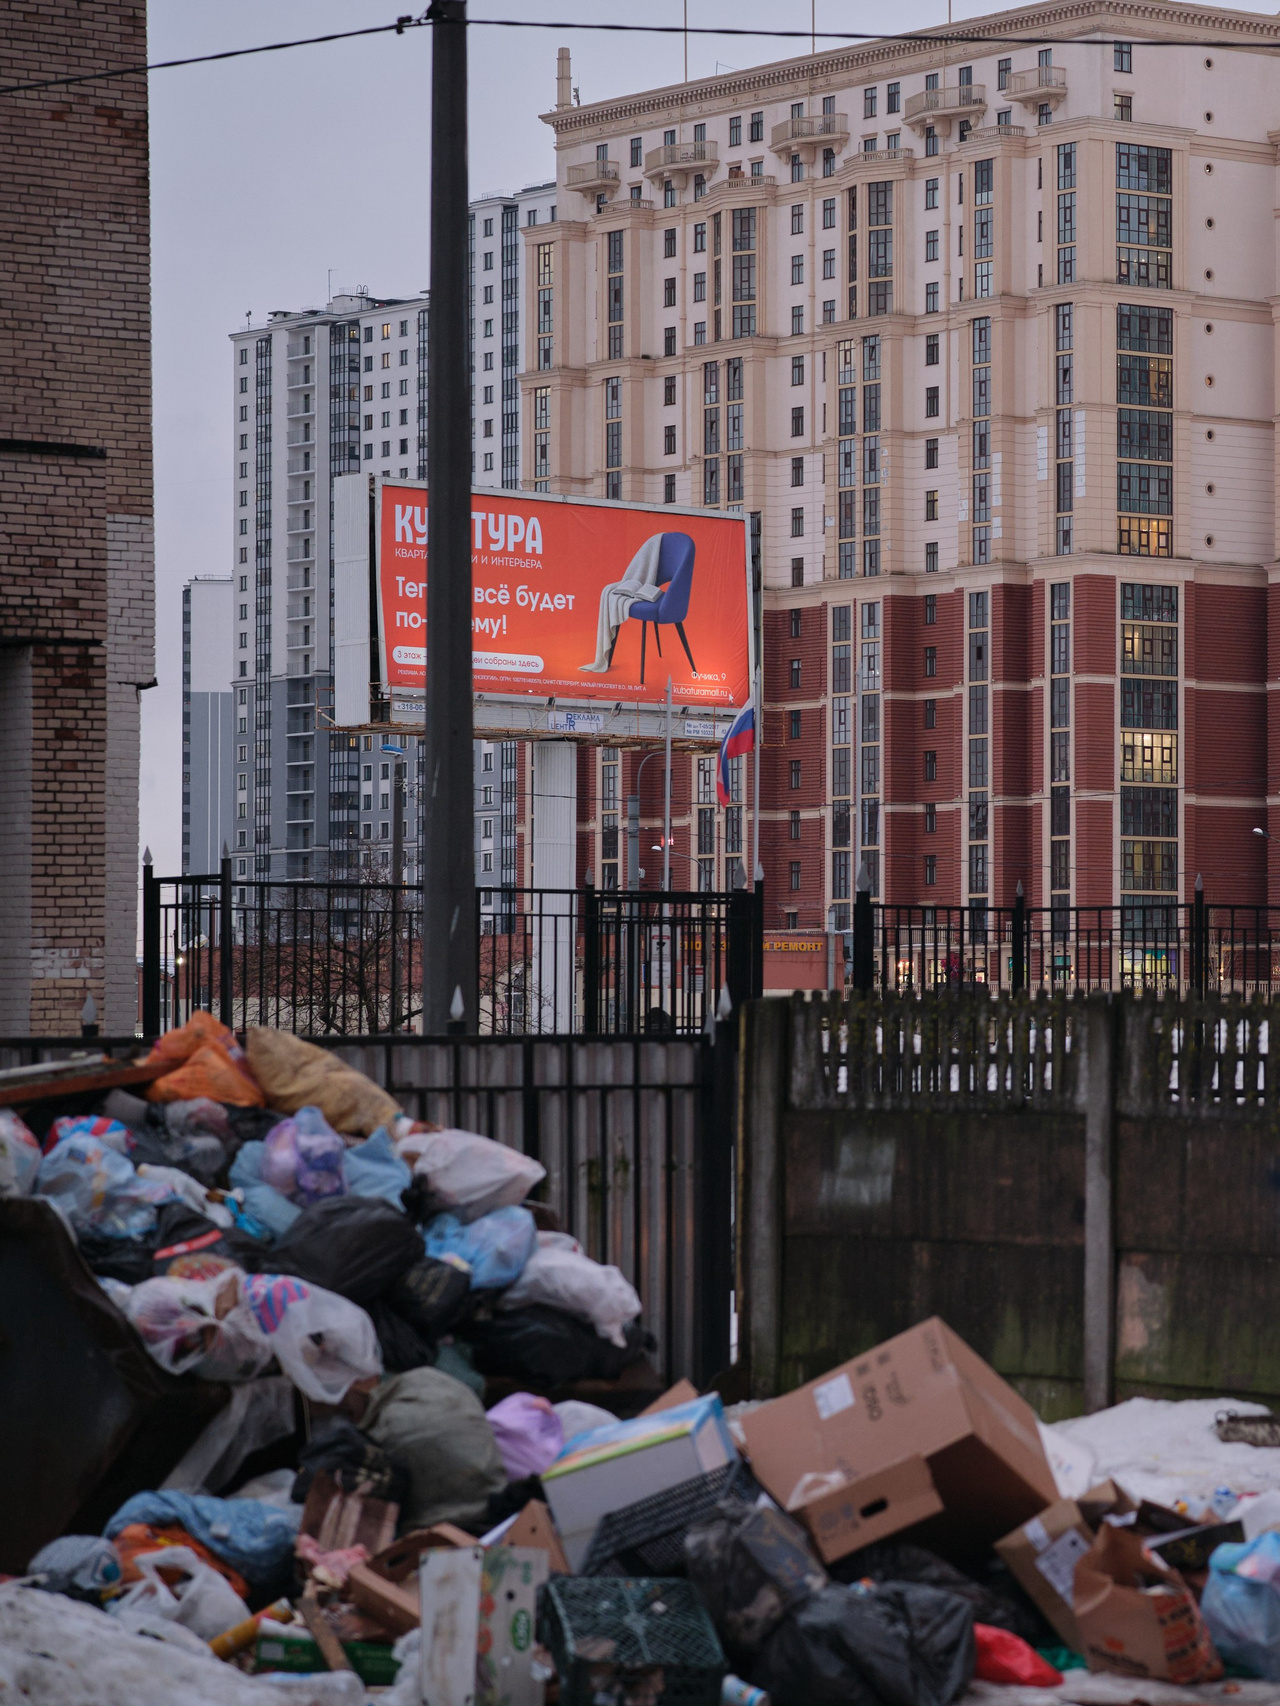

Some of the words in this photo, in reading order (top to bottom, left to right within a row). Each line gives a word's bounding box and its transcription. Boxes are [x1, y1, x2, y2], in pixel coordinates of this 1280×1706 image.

[395, 504, 543, 554] КУТУРА
[491, 557, 543, 570] ИНТЕРЬЕРА
[474, 584, 510, 604] всё
[515, 585, 575, 612] будет
[397, 650, 402, 659] 3
[403, 652, 422, 660] этаж
[484, 657, 516, 667] собраны
[518, 660, 539, 668] здесь
[721, 672, 727, 680] 9
[673, 686, 728, 697] kubaturamall.ru
[774, 941, 823, 952] РЕМОНТ
